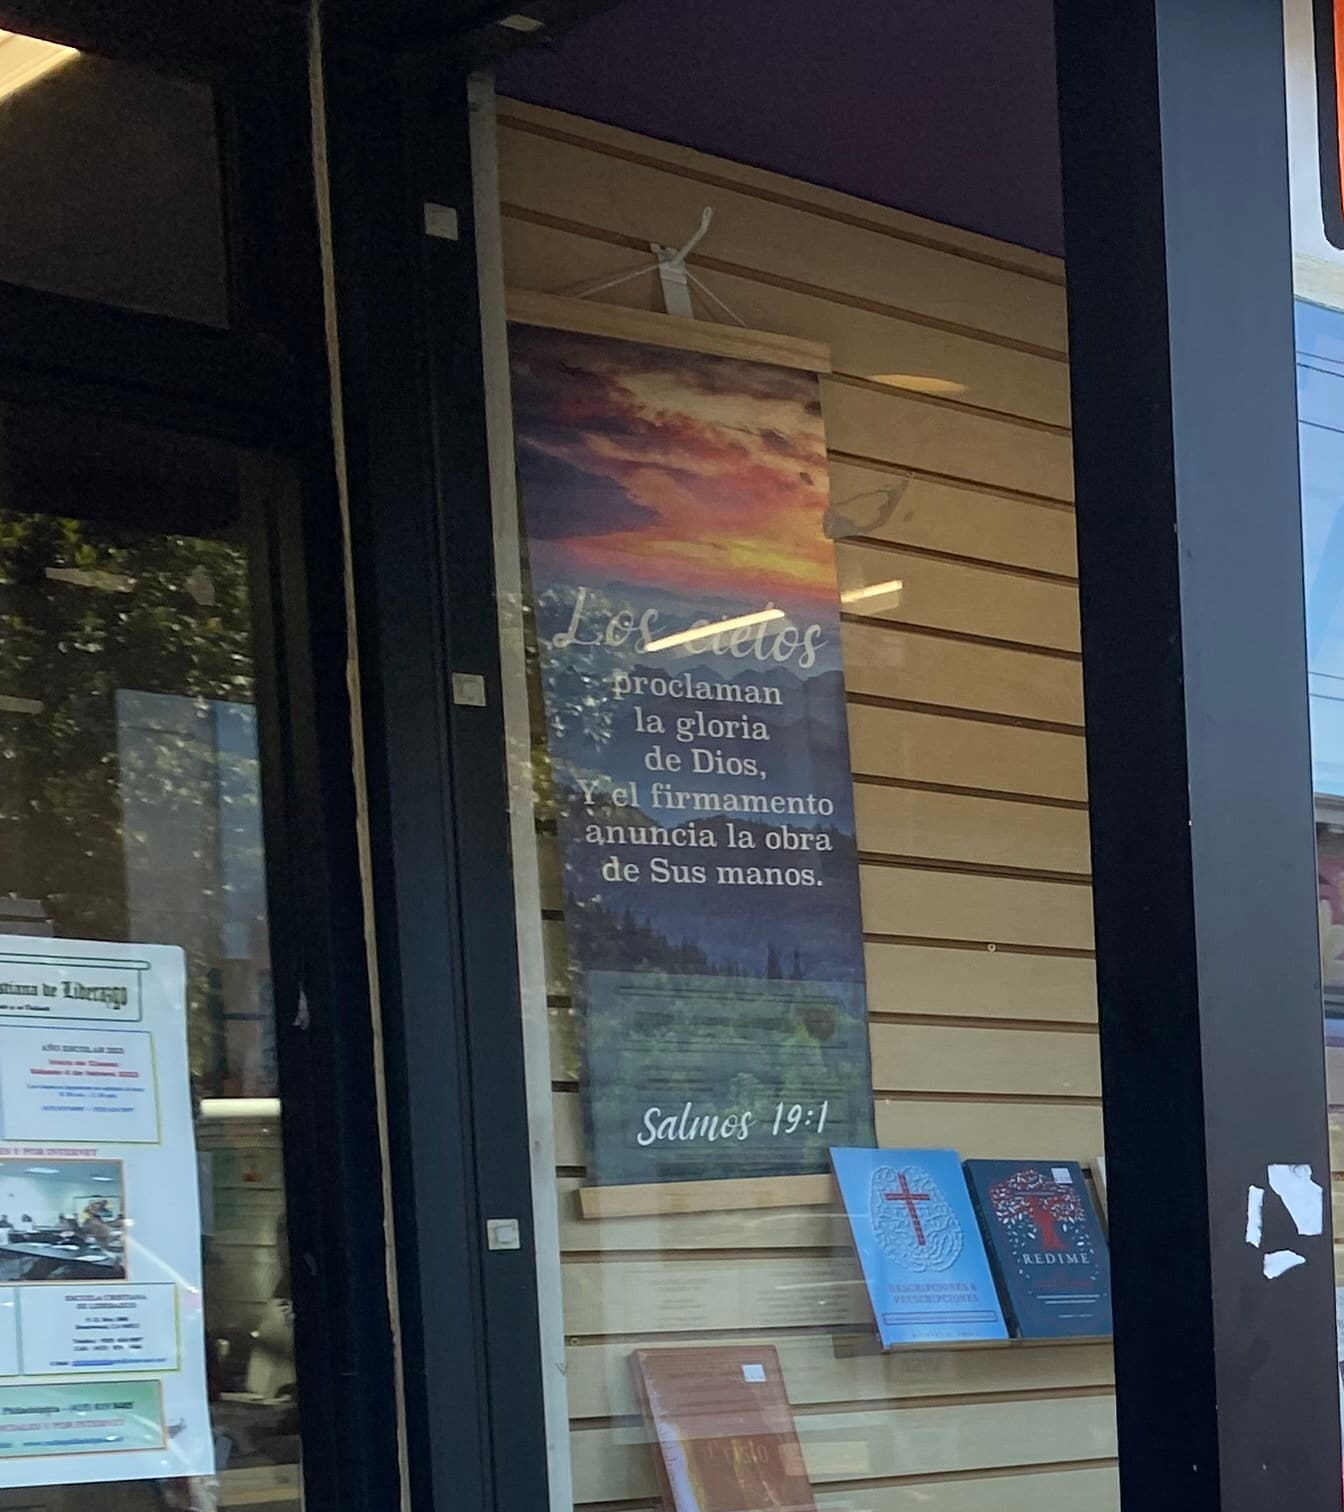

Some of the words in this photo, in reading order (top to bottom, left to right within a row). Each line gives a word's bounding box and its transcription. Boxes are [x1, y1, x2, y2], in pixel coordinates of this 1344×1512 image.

[553, 586, 665, 651] Los
[613, 671, 783, 705] proclaman
[634, 706, 665, 733] la
[676, 711, 770, 742] gloria
[645, 746, 681, 772] de
[693, 749, 766, 781] Dios,
[577, 779, 598, 805] Y
[612, 782, 640, 807] el
[651, 783, 834, 816] firmamento
[585, 822, 716, 847] anuncia
[726, 823, 755, 849] la
[765, 825, 832, 851] obra
[602, 856, 640, 882] de
[650, 857, 707, 883] Sus
[717, 866, 823, 886] manos.
[637, 1101, 757, 1146] Salmos
[772, 1100, 828, 1134] 19:1
[1022, 1253, 1090, 1265] REDIME
